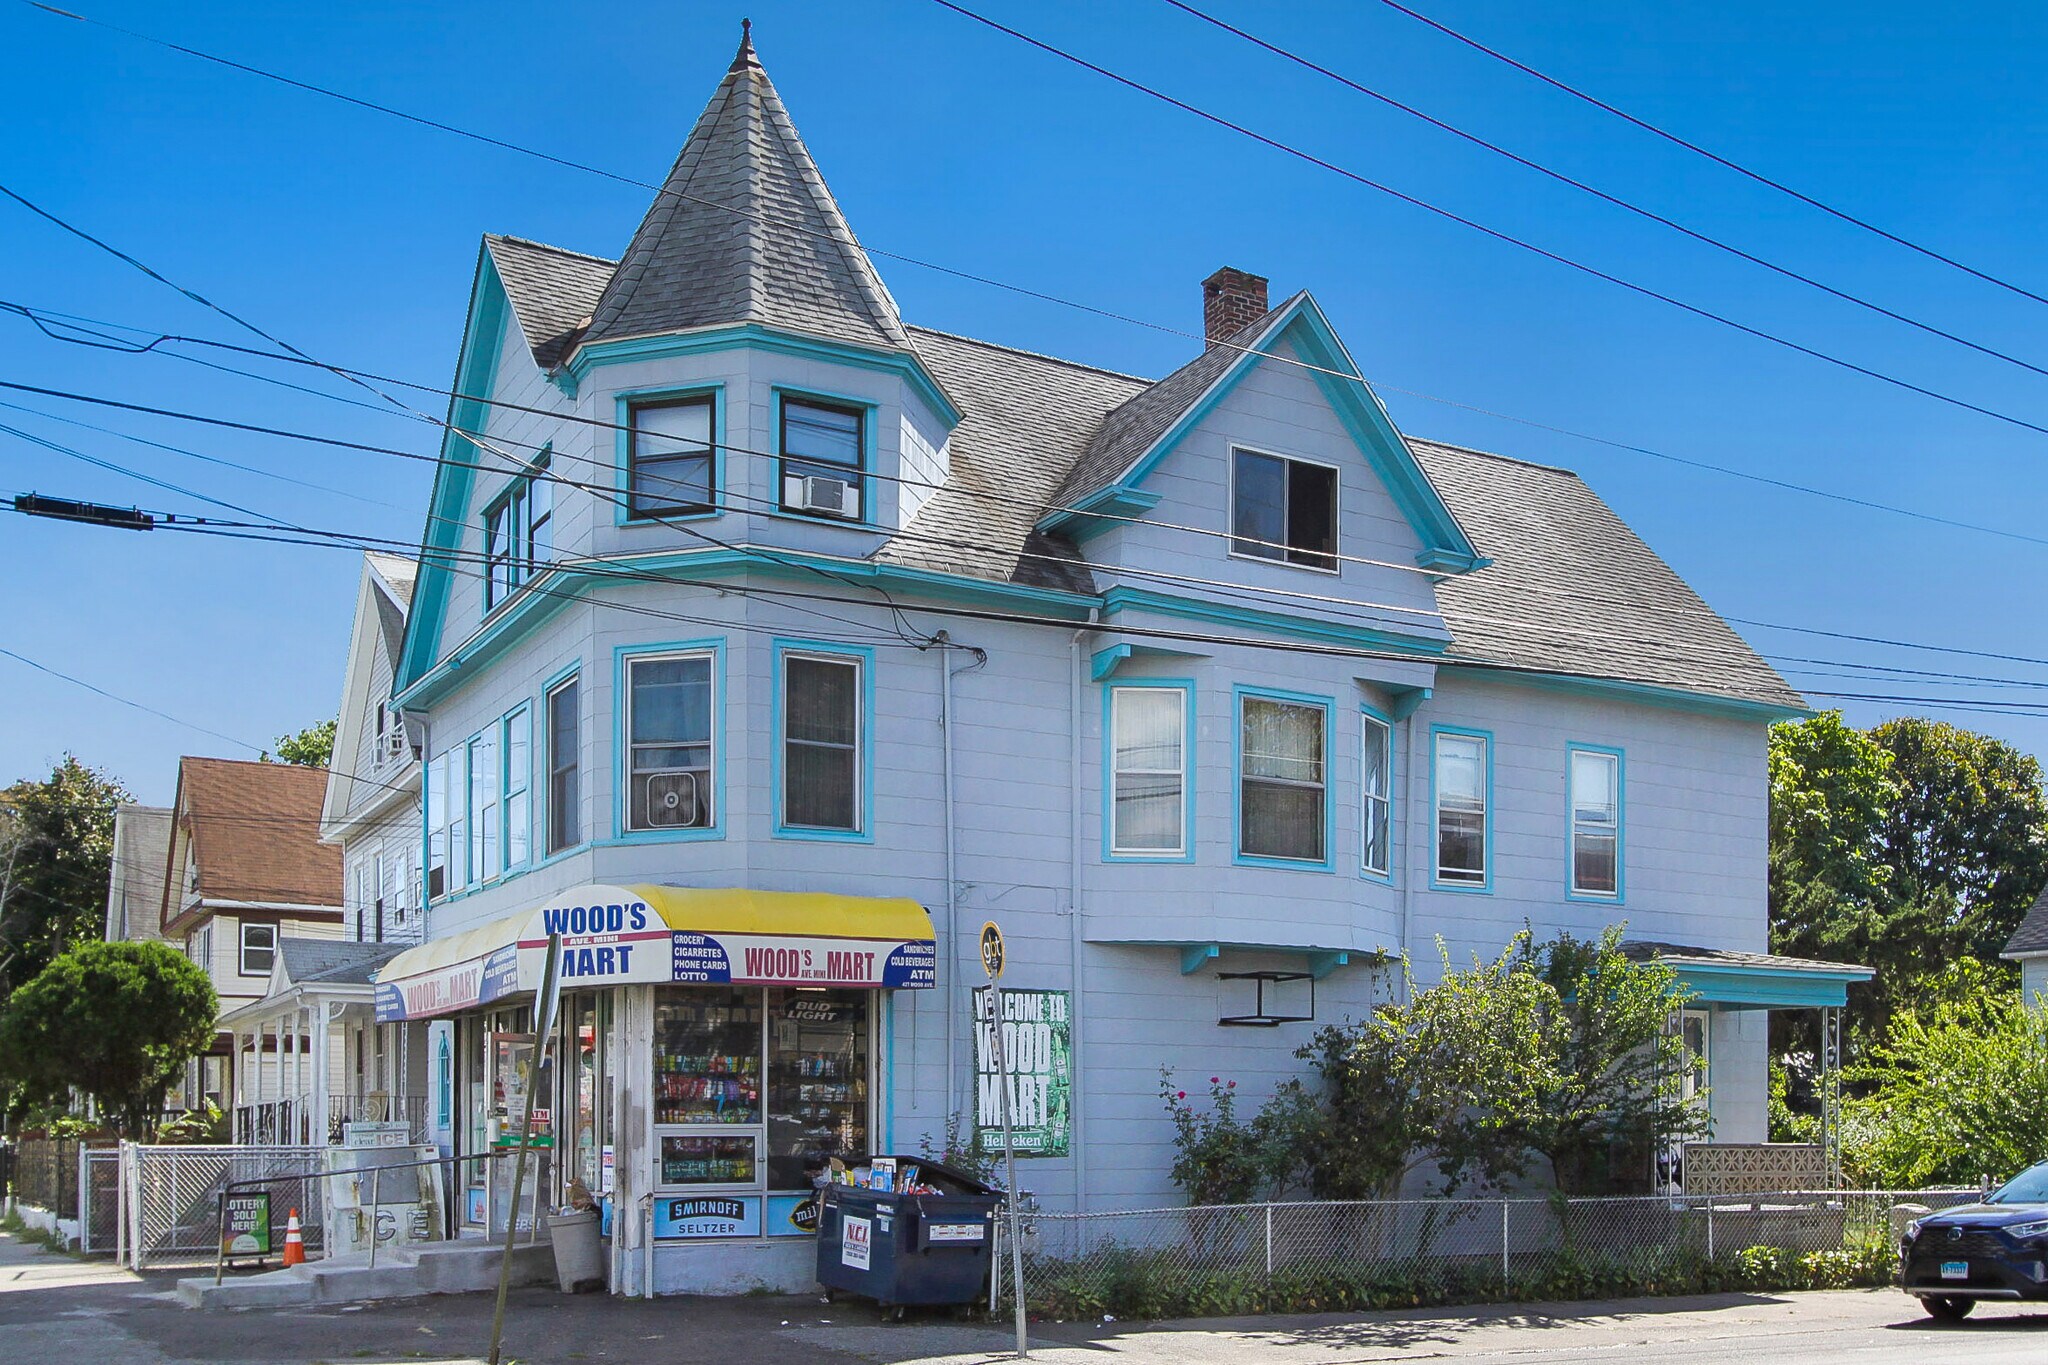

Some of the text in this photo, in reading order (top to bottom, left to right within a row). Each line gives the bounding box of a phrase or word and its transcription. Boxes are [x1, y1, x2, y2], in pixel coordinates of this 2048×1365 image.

[543, 902, 646, 936] WOOD'S
[594, 935, 618, 944] MINI
[674, 935, 705, 945] GROCERY
[674, 947, 722, 958] CIGARRETES
[903, 945, 934, 955] SANDWICHES
[674, 960, 727, 970] PHONE CARDS
[745, 948, 875, 980] WOOD'S MART
[891, 956, 934, 967] COLD BEVERAGES
[674, 972, 708, 980] LOTTO
[910, 970, 934, 979] ATM
[449, 968, 479, 1004] MART
[795, 1001, 831, 1011] BUD
[975, 991, 1065, 1022] WLCOME TO
[787, 1010, 837, 1021] LIGHT
[976, 1021, 1051, 1072] WOOD
[377, 1133, 404, 1146] ICE
[983, 1134, 1042, 1147] Heieken
[226, 1199, 265, 1210] OTTERY
[675, 1201, 739, 1217] SMIRNOFF
[233, 1211, 257, 1220] SOLD
[231, 1221, 259, 1231] HERE!
[678, 1223, 736, 1234] SELTZER
